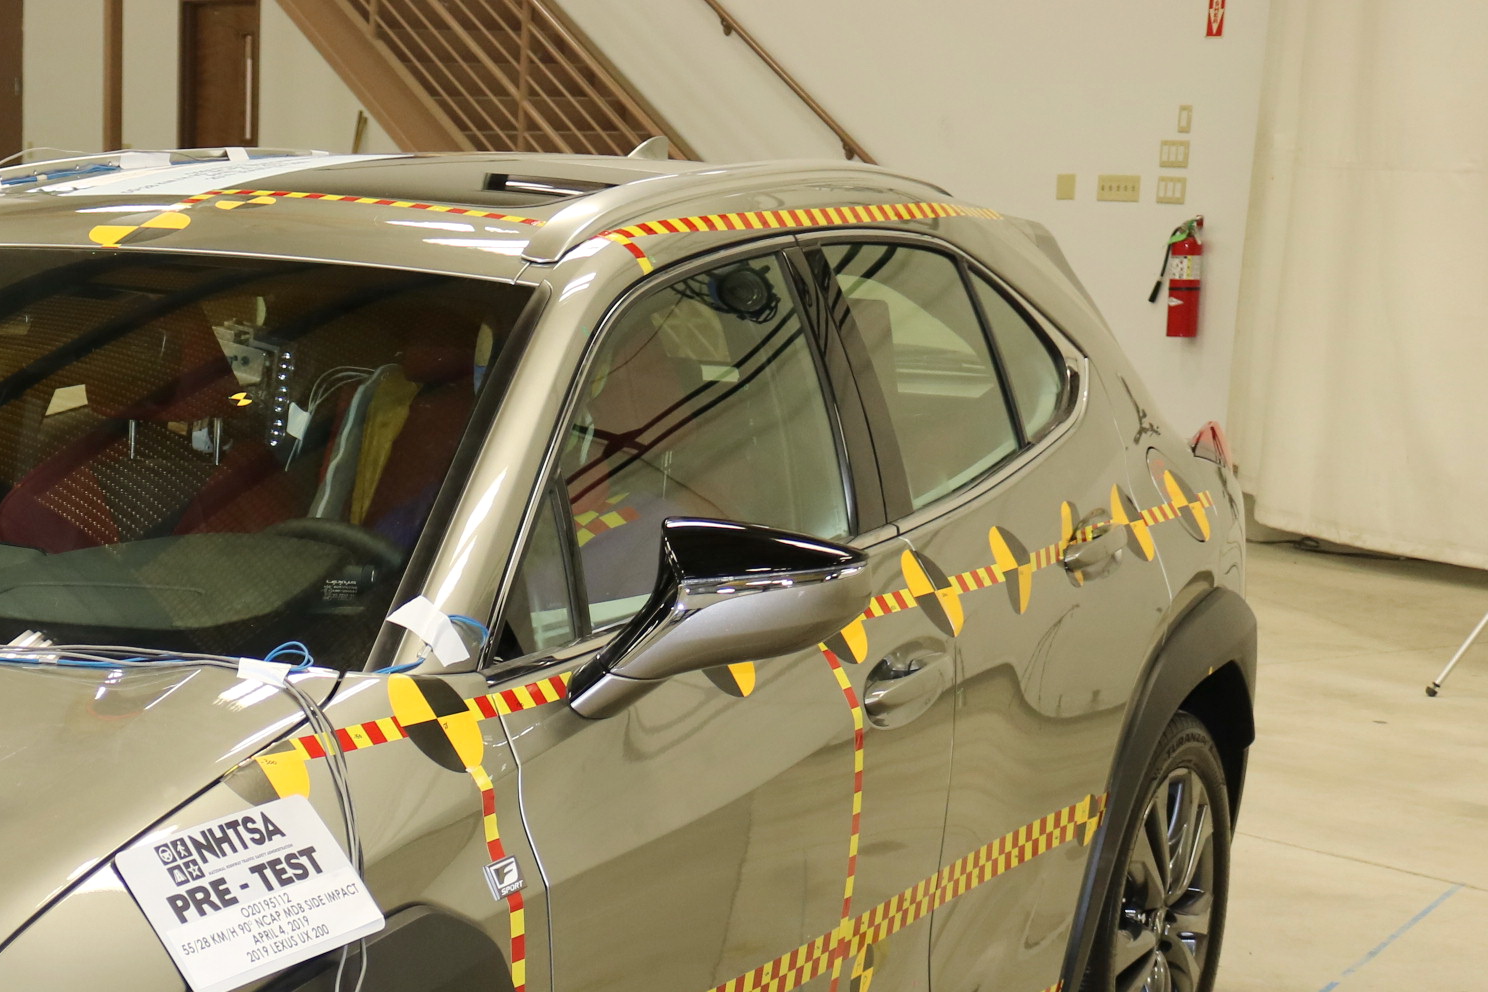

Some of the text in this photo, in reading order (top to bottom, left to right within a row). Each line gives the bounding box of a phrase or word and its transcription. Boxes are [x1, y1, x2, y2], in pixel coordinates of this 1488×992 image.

[187, 811, 287, 864] NHTSA
[166, 877, 239, 924] PRE
[248, 846, 323, 892] TEST
[240, 892, 292, 918] O20195112
[501, 879, 524, 896] SPORT
[181, 936, 211, 956] 55/28
[210, 926, 239, 945] KM/H
[254, 910, 281, 929] NCAP
[283, 902, 305, 919] MDB
[304, 895, 326, 911] SIDE
[325, 883, 360, 904] IMPACT
[252, 928, 279, 946] APRIL
[287, 915, 310, 932] 2019
[246, 923, 330, 963] 2019 LEXUS UX 200
